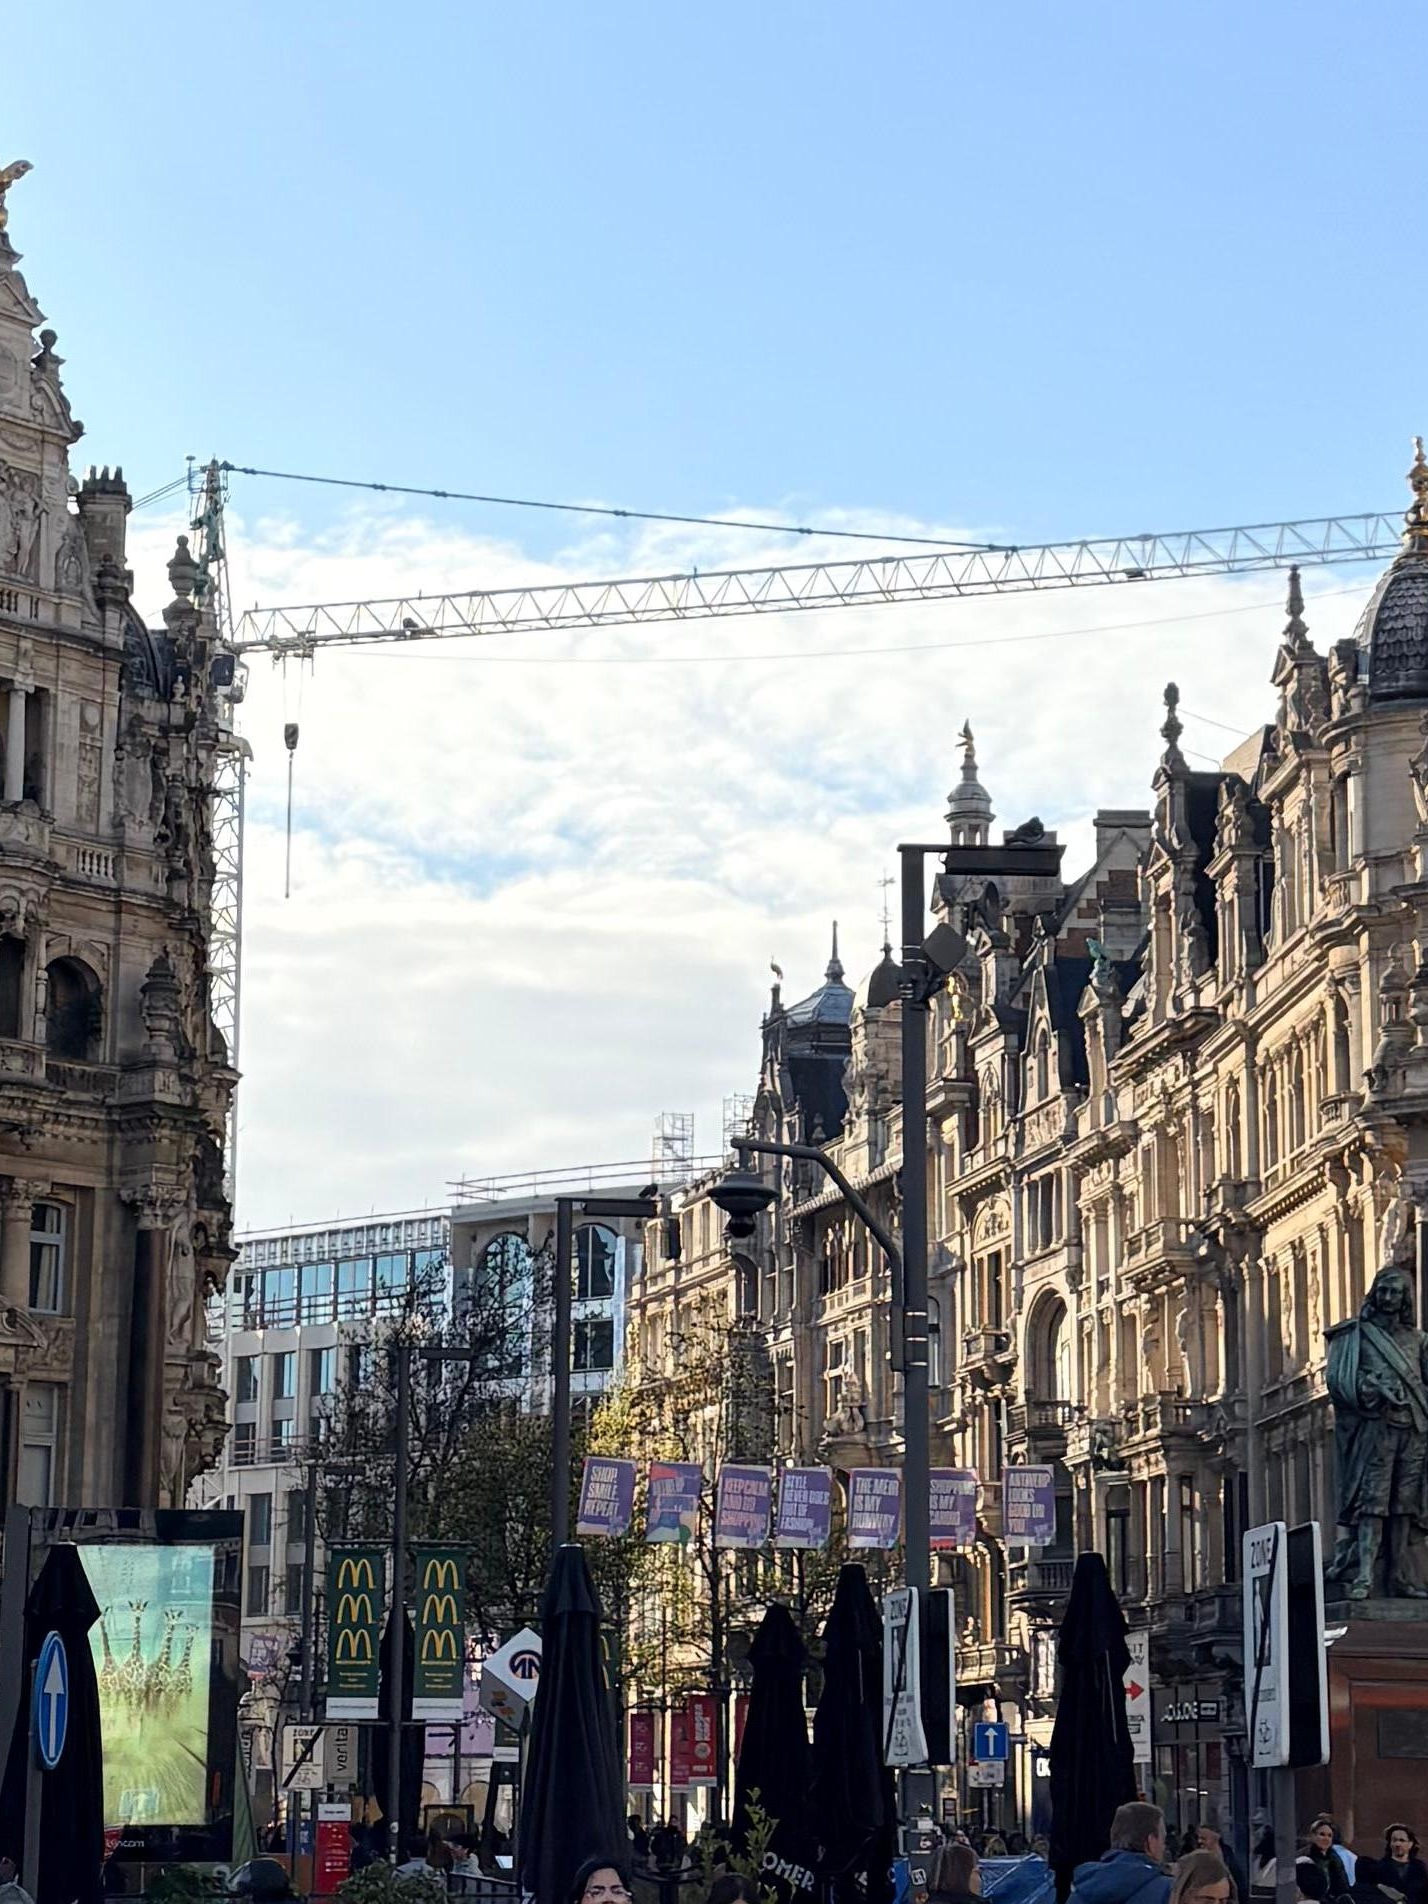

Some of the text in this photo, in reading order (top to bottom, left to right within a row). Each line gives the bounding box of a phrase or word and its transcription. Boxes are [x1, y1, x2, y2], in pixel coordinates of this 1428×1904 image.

[856, 1477, 899, 1496] THE MEIR
[784, 1489, 808, 1502] NEVER
[854, 1495, 882, 1512] IS MY
[939, 1496, 955, 1510] MY
[852, 1511, 895, 1529] RUNWAY
[762, 1851, 815, 1892] OMER
